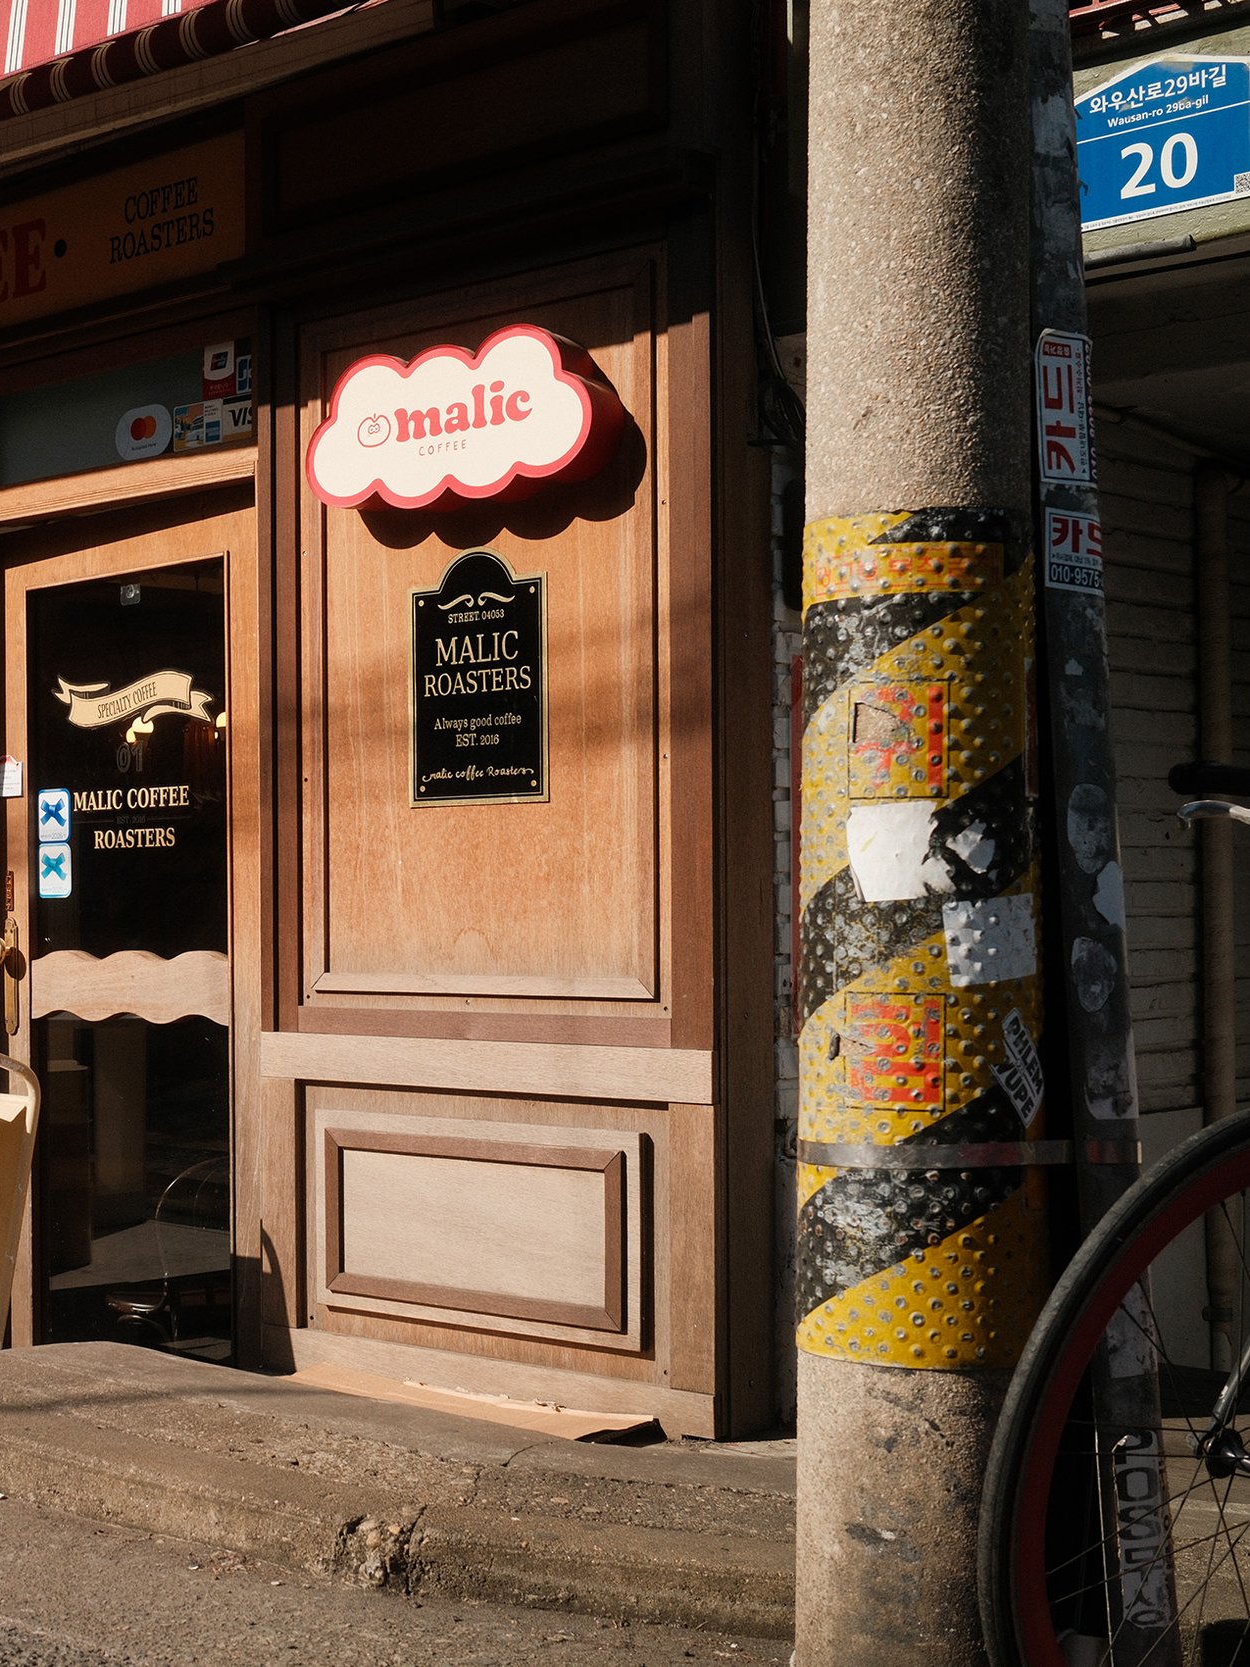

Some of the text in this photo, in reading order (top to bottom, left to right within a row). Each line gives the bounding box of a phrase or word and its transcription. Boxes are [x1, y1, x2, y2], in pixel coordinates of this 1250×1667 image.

[1089, 64, 1227, 115] 와우산로29바길
[1107, 94, 1209, 129] Wausan-ro 29ba-gil
[1120, 132, 1198, 200] 20
[124, 176, 199, 225] COFFEE
[109, 209, 216, 264] ROASTERS
[229, 407, 252, 427] VIS
[394, 380, 532, 442] malic
[1043, 364, 1076, 474] 카드
[418, 439, 468, 457] COFFEE
[1052, 517, 1103, 558] 카드
[481, 608, 505, 621] 04053
[435, 630, 519, 667] MALIC
[424, 665, 532, 698] ROASTERS
[97, 681, 158, 719] SPECIALTY COFFEE
[434, 712, 522, 732] Always good coffee
[455, 733, 499, 748] EST. 2016
[422, 765, 534, 783] malic coffee Roasters
[73, 785, 190, 813] MALIC COFFEE
[94, 827, 176, 850] ROASTERS
